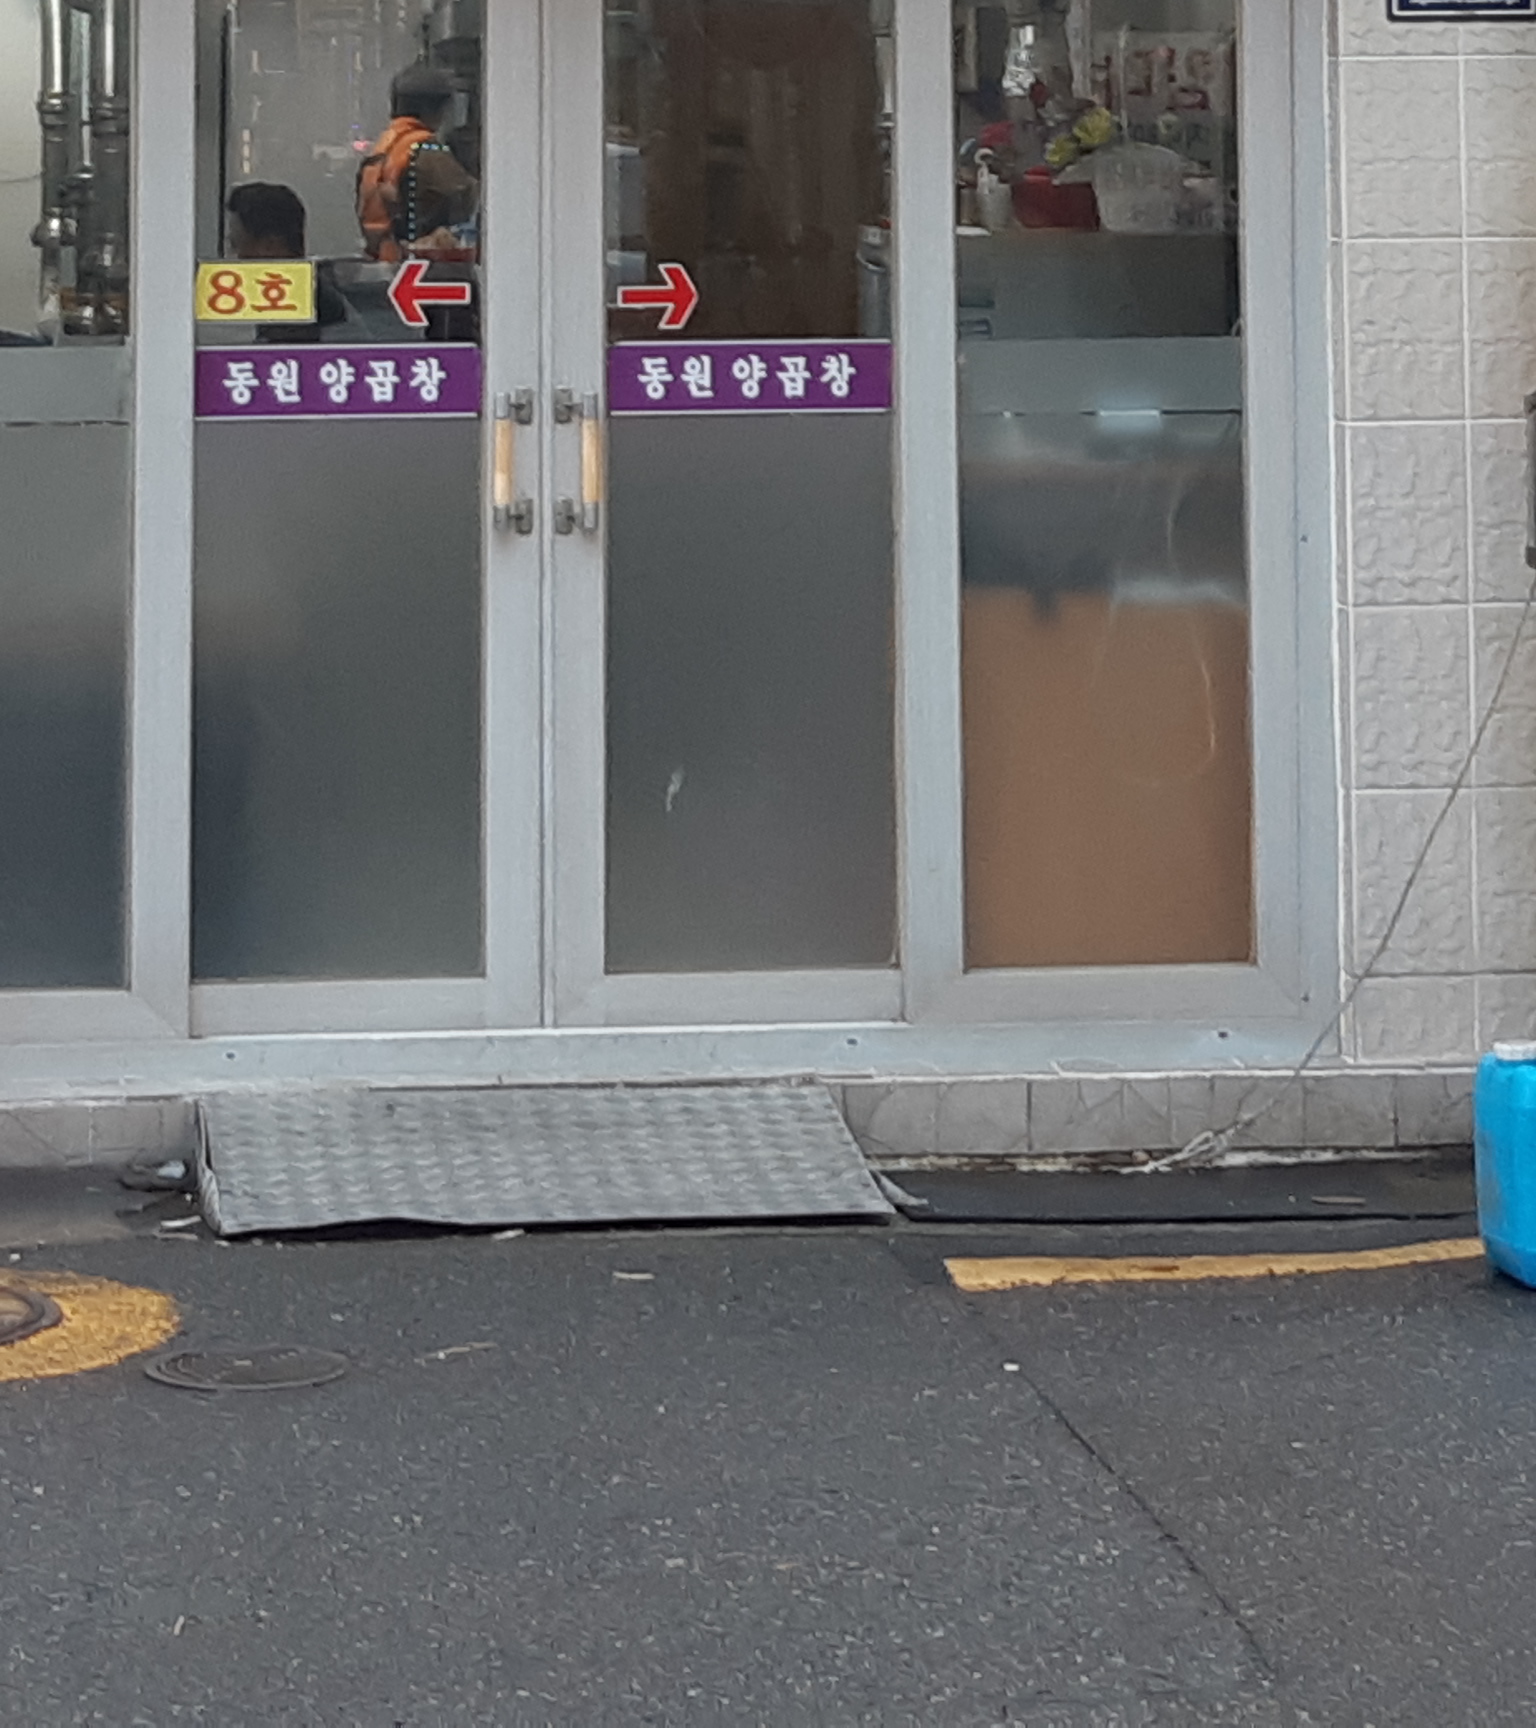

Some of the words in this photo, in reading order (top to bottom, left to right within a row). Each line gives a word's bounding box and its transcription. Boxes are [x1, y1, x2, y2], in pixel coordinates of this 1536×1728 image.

[207, 270, 298, 315] 8호
[222, 358, 301, 405] 동원
[319, 357, 447, 404] 양곱창
[637, 355, 714, 400] 동원
[731, 353, 857, 399] 양곱창
